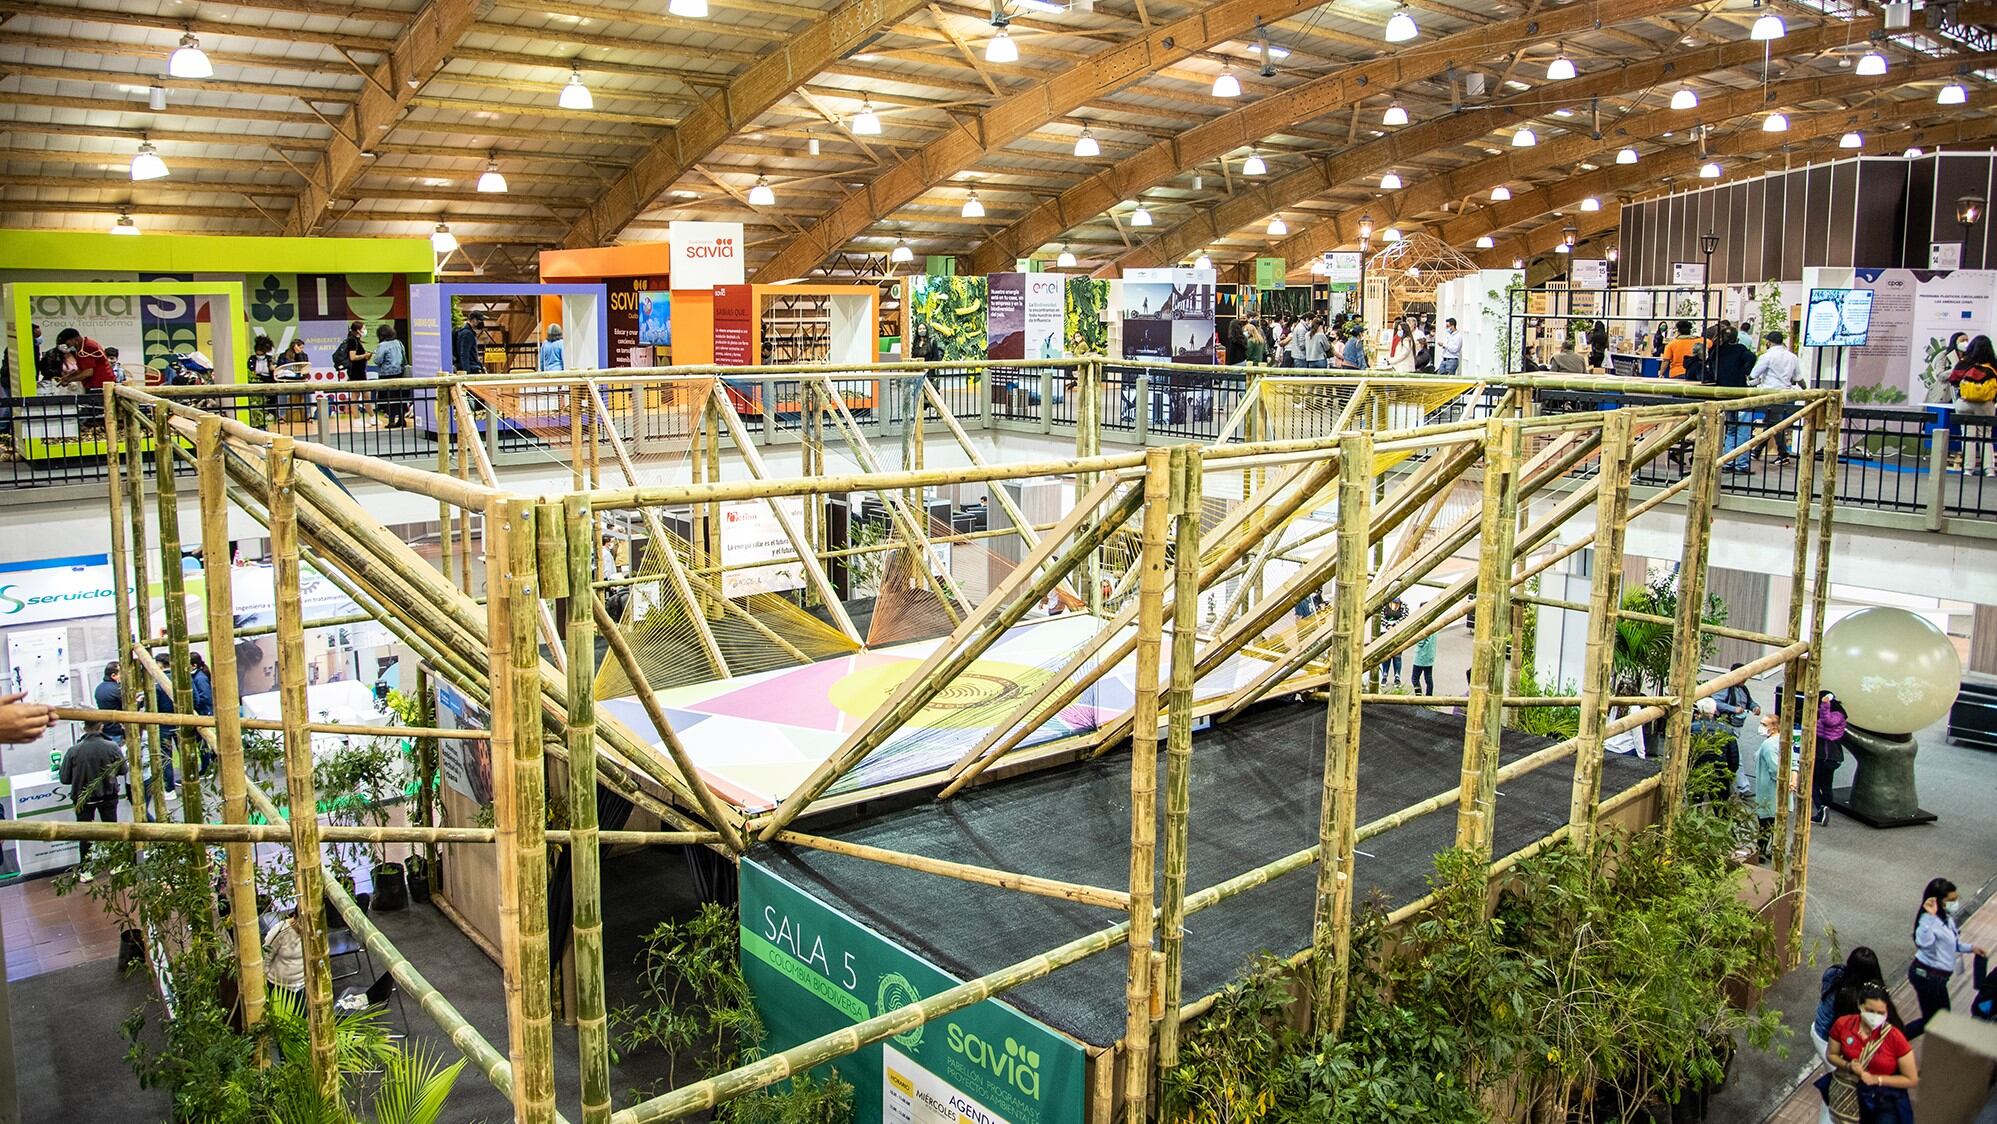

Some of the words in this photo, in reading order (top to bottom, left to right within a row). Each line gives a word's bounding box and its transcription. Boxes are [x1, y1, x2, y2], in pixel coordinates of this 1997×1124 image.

[687, 238, 733, 258] savia
[1033, 280, 1059, 294] enel
[611, 290, 638, 310] savi
[42, 319, 67, 328] Crea
[77, 318, 133, 328] Transforma
[313, 594, 347, 603] tratamiento
[19, 793, 52, 803] grupo
[764, 905, 830, 976] SALA
[842, 951, 857, 990] 5
[769, 950, 812, 986] COLOMBIA
[813, 976, 864, 1020] BIODIVERSA
[947, 1022, 1040, 1101] savia
[890, 1075, 910, 1091] HORARIO
[947, 1066, 990, 1099] PROYECTOS
[916, 1089, 957, 1122] MIÉRCOLES
